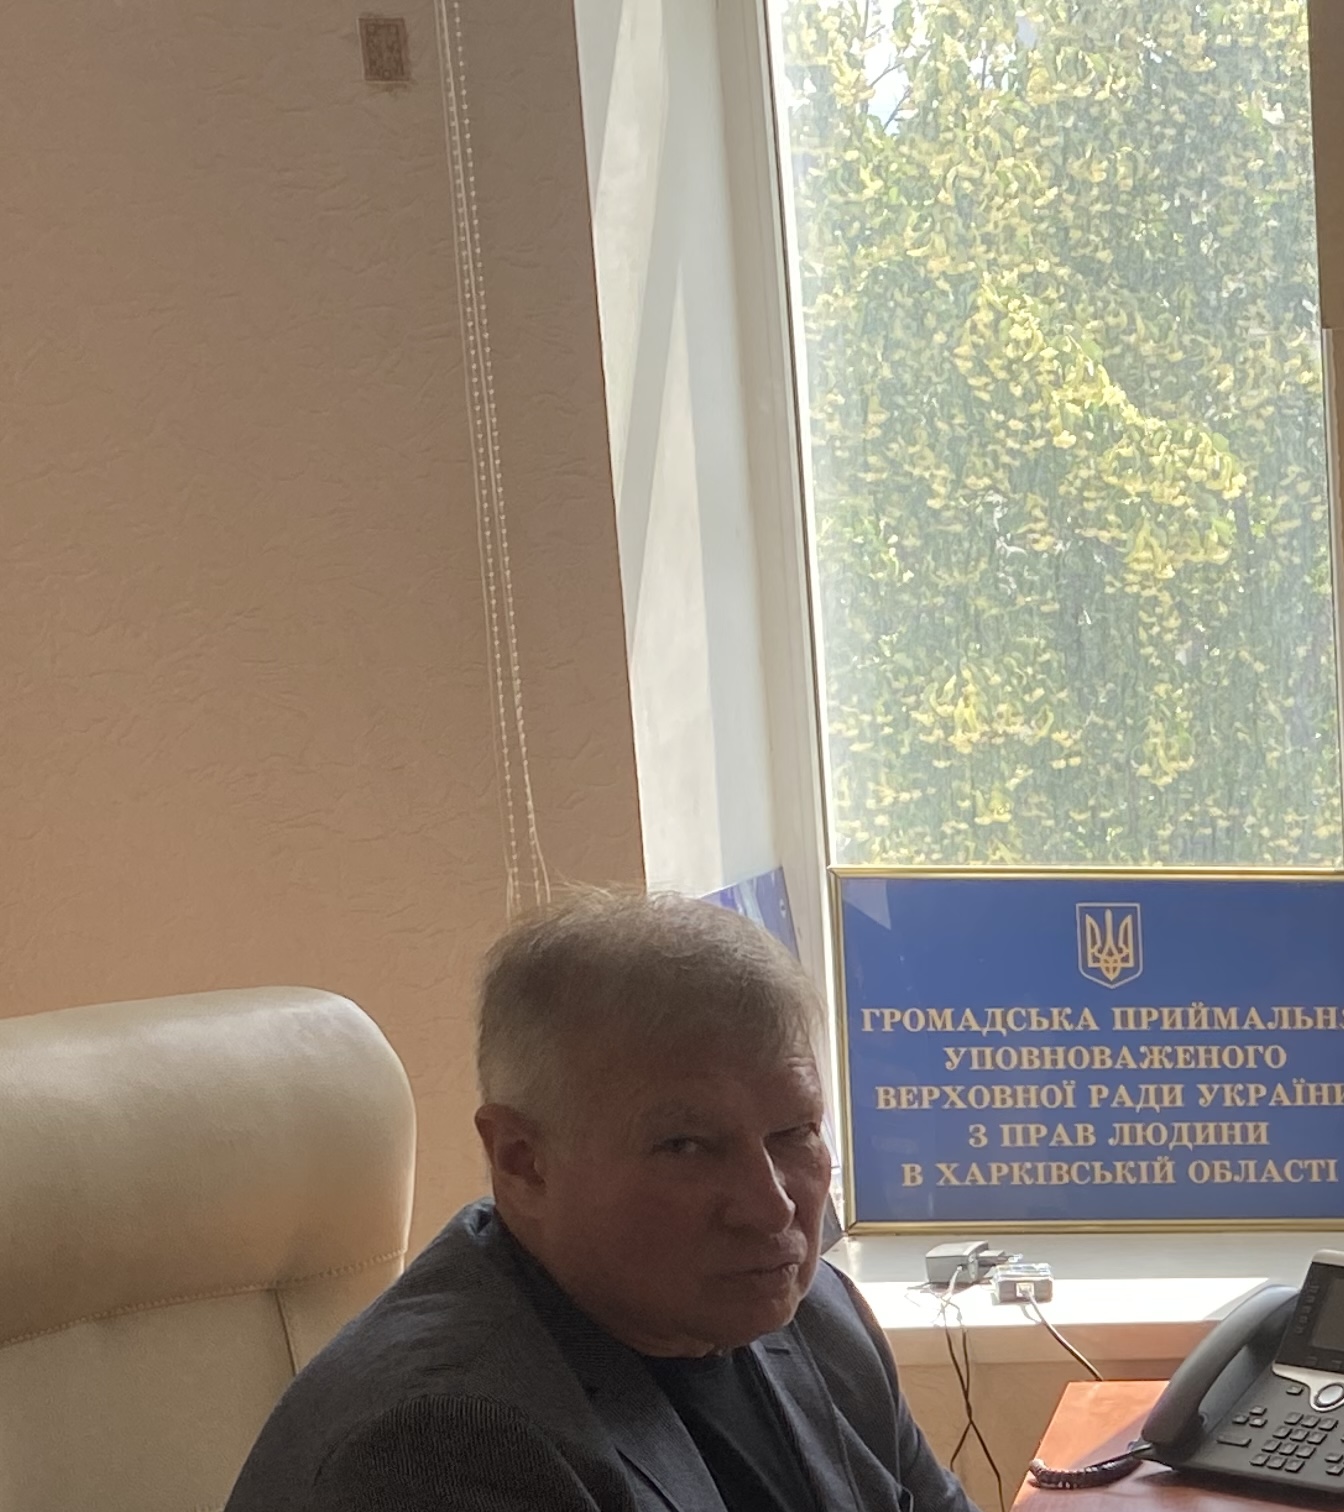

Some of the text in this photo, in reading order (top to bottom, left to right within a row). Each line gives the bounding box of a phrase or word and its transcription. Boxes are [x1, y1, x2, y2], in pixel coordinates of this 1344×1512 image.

[862, 1007, 1099, 1036] ГРОМАДСЬКА
[944, 1044, 1288, 1072] УПОВНОВАЖЕНОГО
[876, 1080, 1077, 1110] ВЕРХОВНОЇ
[1088, 1082, 1185, 1112] РАДИ
[968, 1120, 1270, 1150] З ПРАВ ЛЮДИНИ
[902, 1155, 1339, 1187] В ХАРКІВСЬКІЙ ОБЛАСТІ
